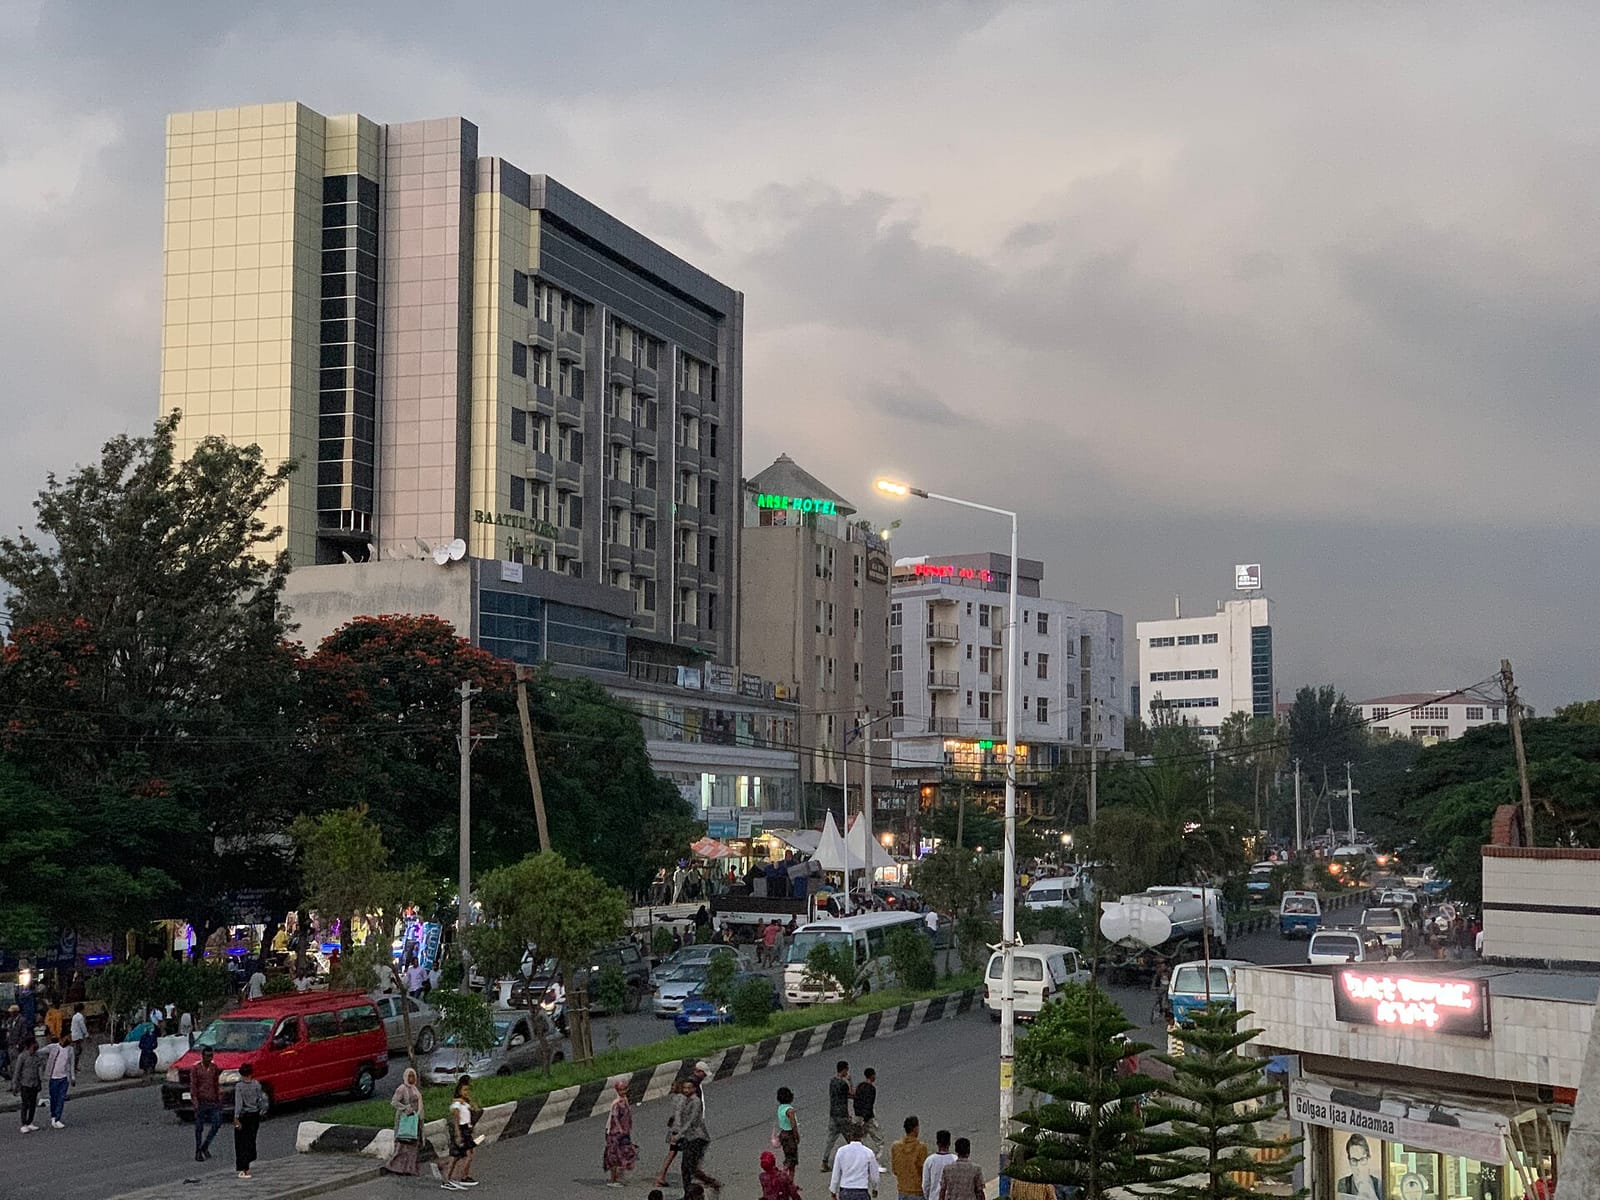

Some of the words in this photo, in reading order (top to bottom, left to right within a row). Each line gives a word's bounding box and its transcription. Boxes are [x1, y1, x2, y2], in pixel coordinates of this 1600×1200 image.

[792, 497, 837, 515] HOTEL
[1296, 1096, 1327, 1120] Golgaa
[1329, 1104, 1347, 1125] Ijaa
[1350, 1109, 1395, 1135] Adaamaa
